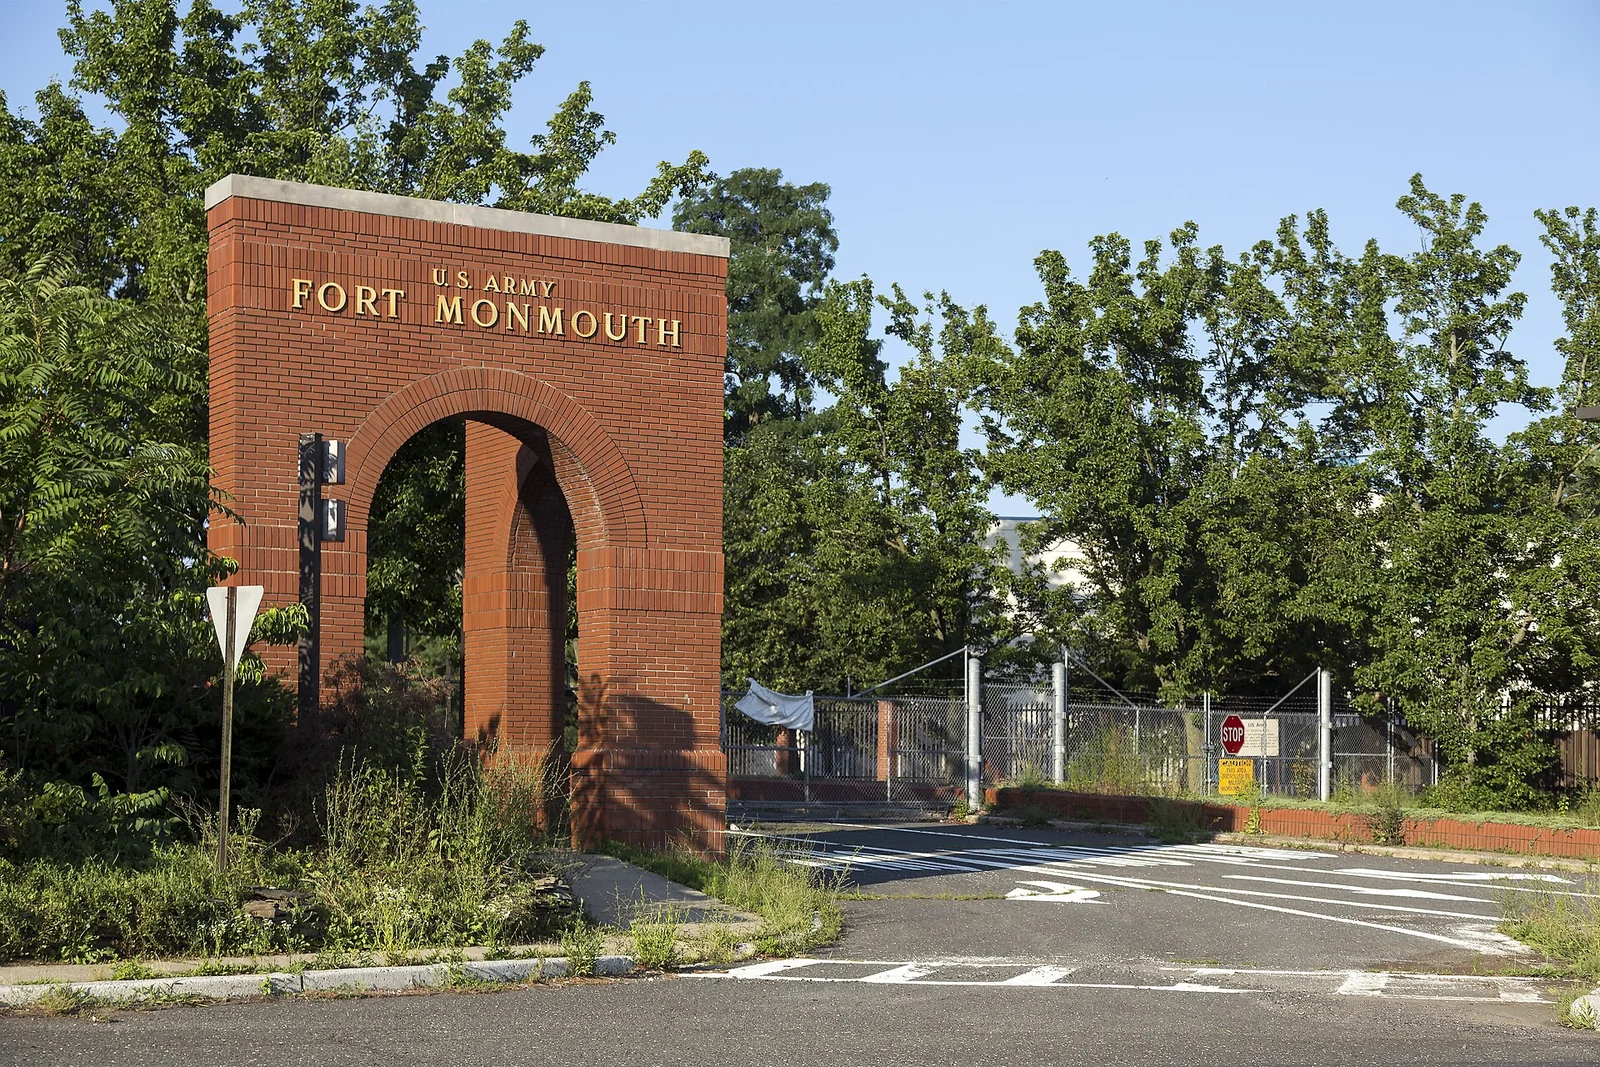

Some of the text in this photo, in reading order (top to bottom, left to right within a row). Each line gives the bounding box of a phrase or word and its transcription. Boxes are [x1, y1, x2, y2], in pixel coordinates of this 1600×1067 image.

[483, 274, 557, 299] ARMY
[291, 278, 682, 347] FORT MONMOUTH
[1223, 727, 1244, 742] STOP
